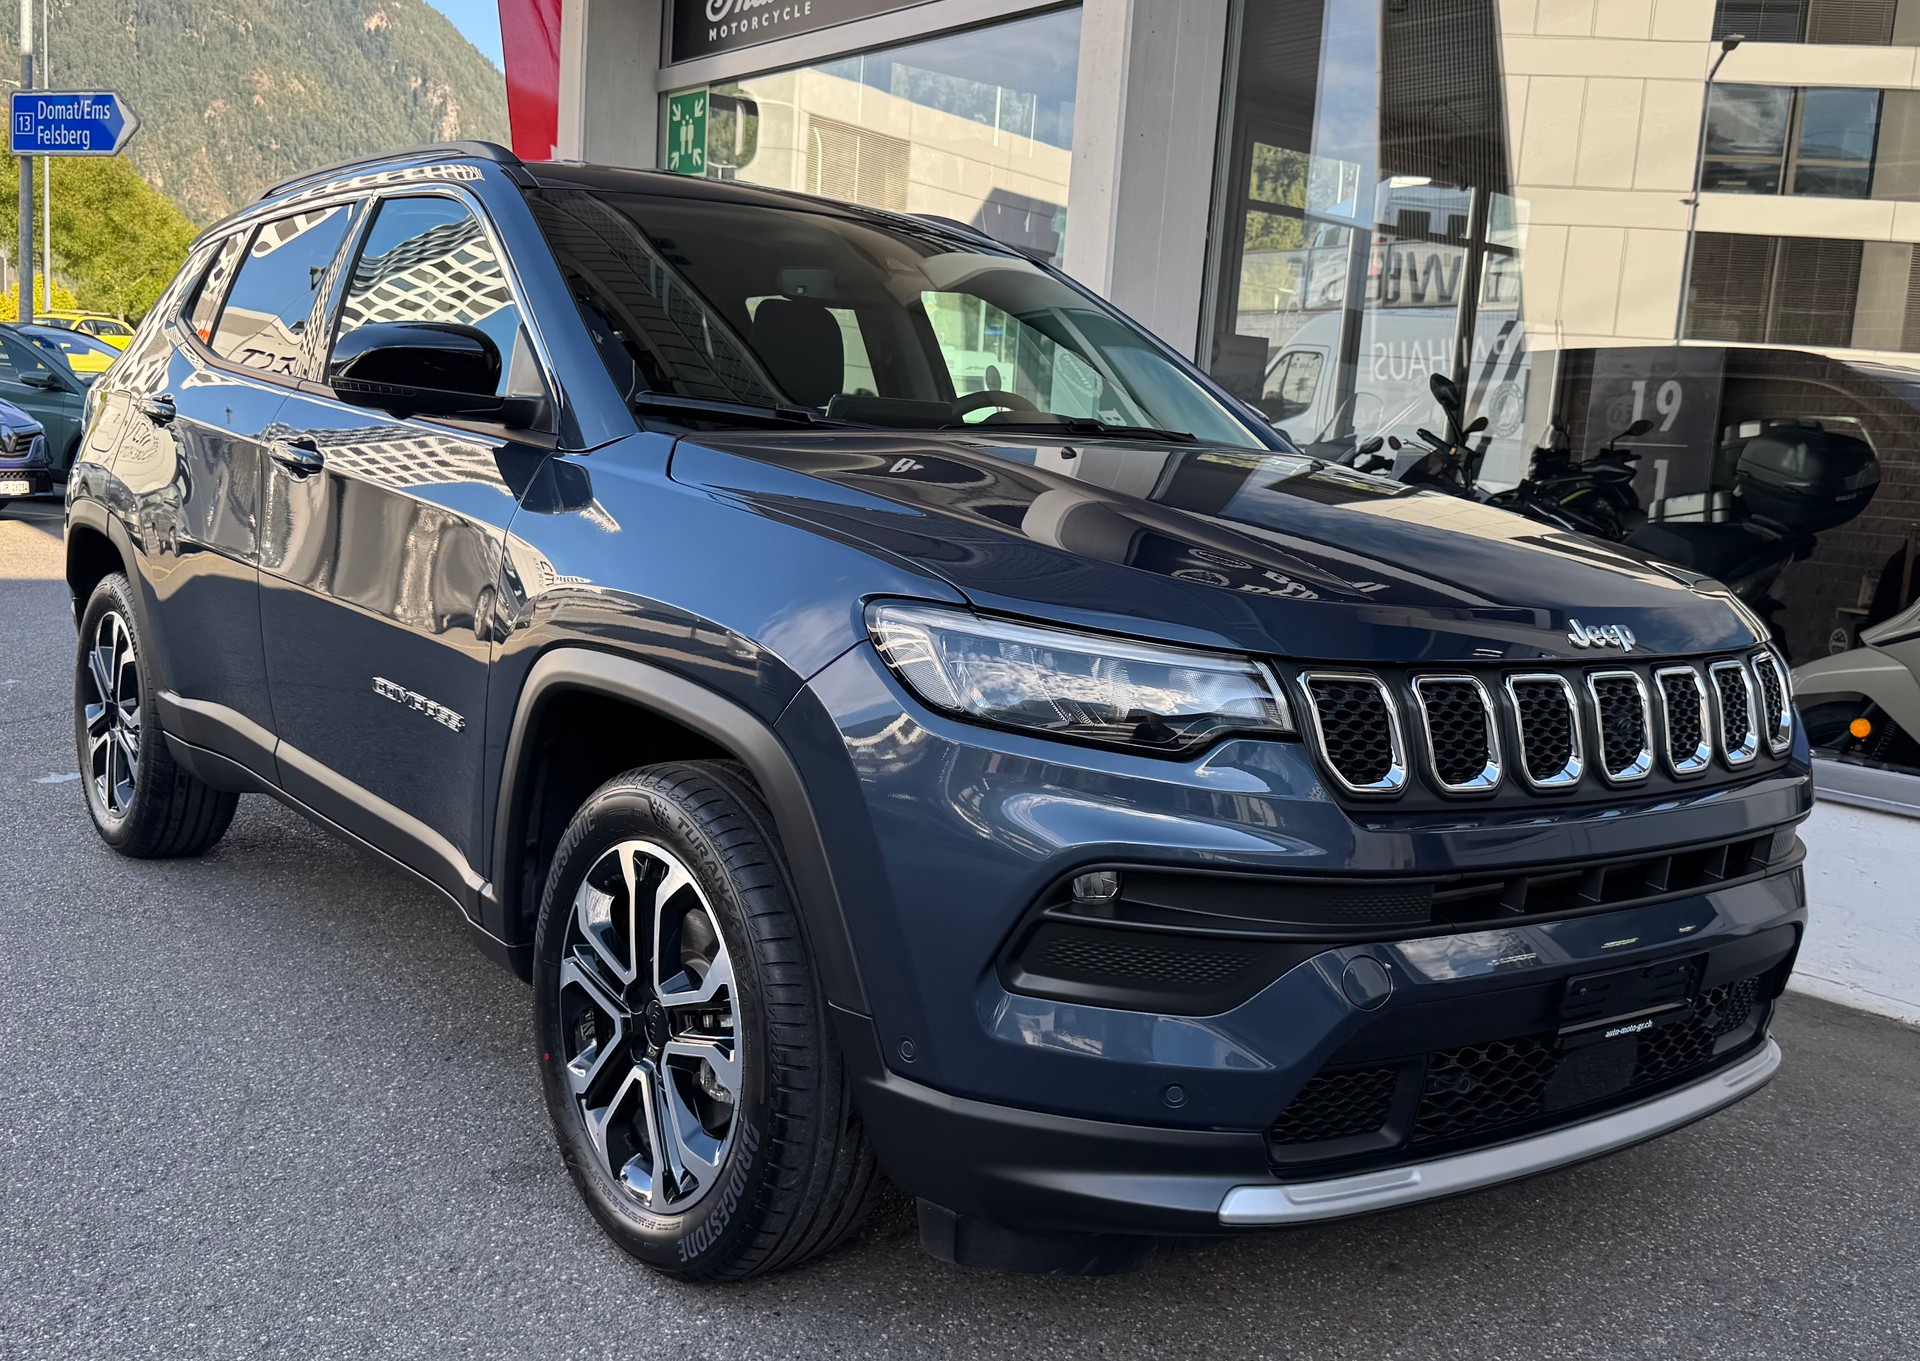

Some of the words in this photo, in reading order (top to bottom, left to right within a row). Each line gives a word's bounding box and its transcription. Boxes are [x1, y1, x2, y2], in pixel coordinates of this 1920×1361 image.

[708, 1, 812, 42] MOTORCYCLE
[18, 116, 31, 132] 13
[37, 100, 111, 120] Domat/Ems
[37, 124, 91, 150] Felsberg
[1566, 618, 1637, 653] Jeep
[676, 1115, 762, 1263] BRIDGESTONE
